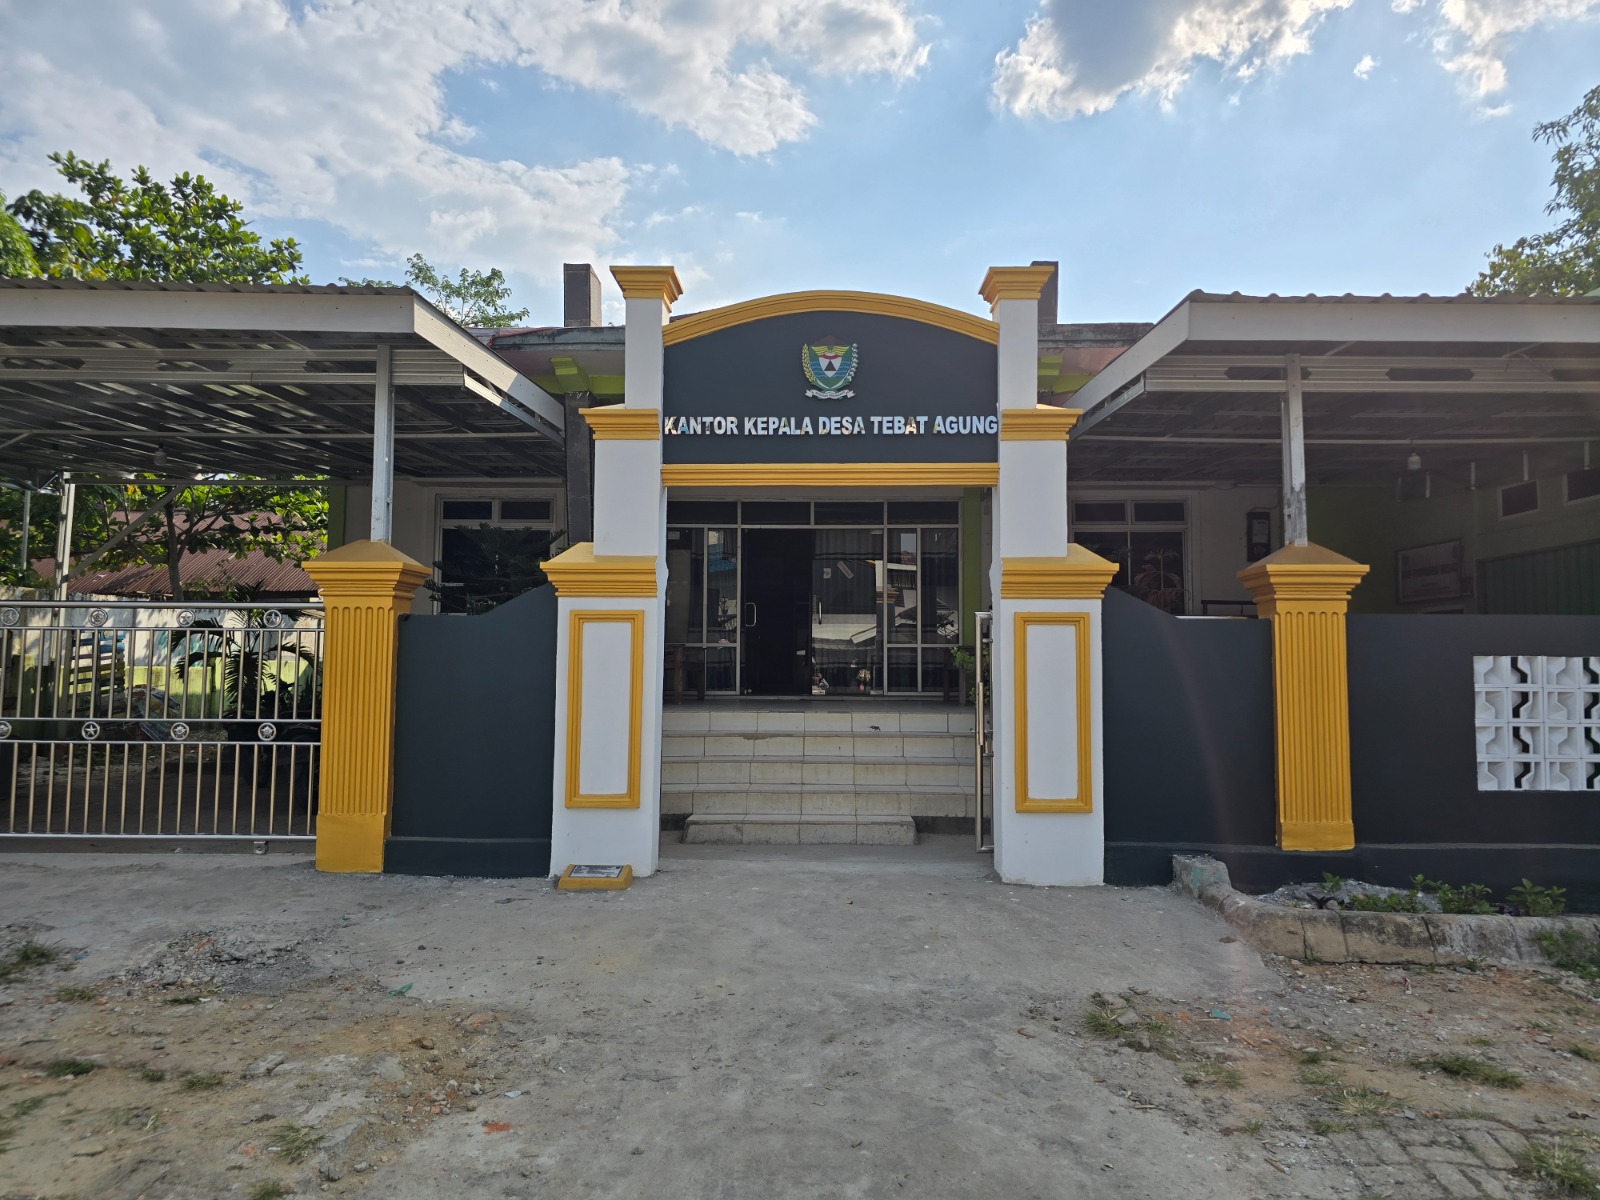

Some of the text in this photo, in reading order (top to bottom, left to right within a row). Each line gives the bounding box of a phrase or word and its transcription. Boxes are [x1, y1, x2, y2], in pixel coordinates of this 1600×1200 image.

[664, 415, 998, 435] KANTOR KEPALA DESA TEBAT AGUNG
